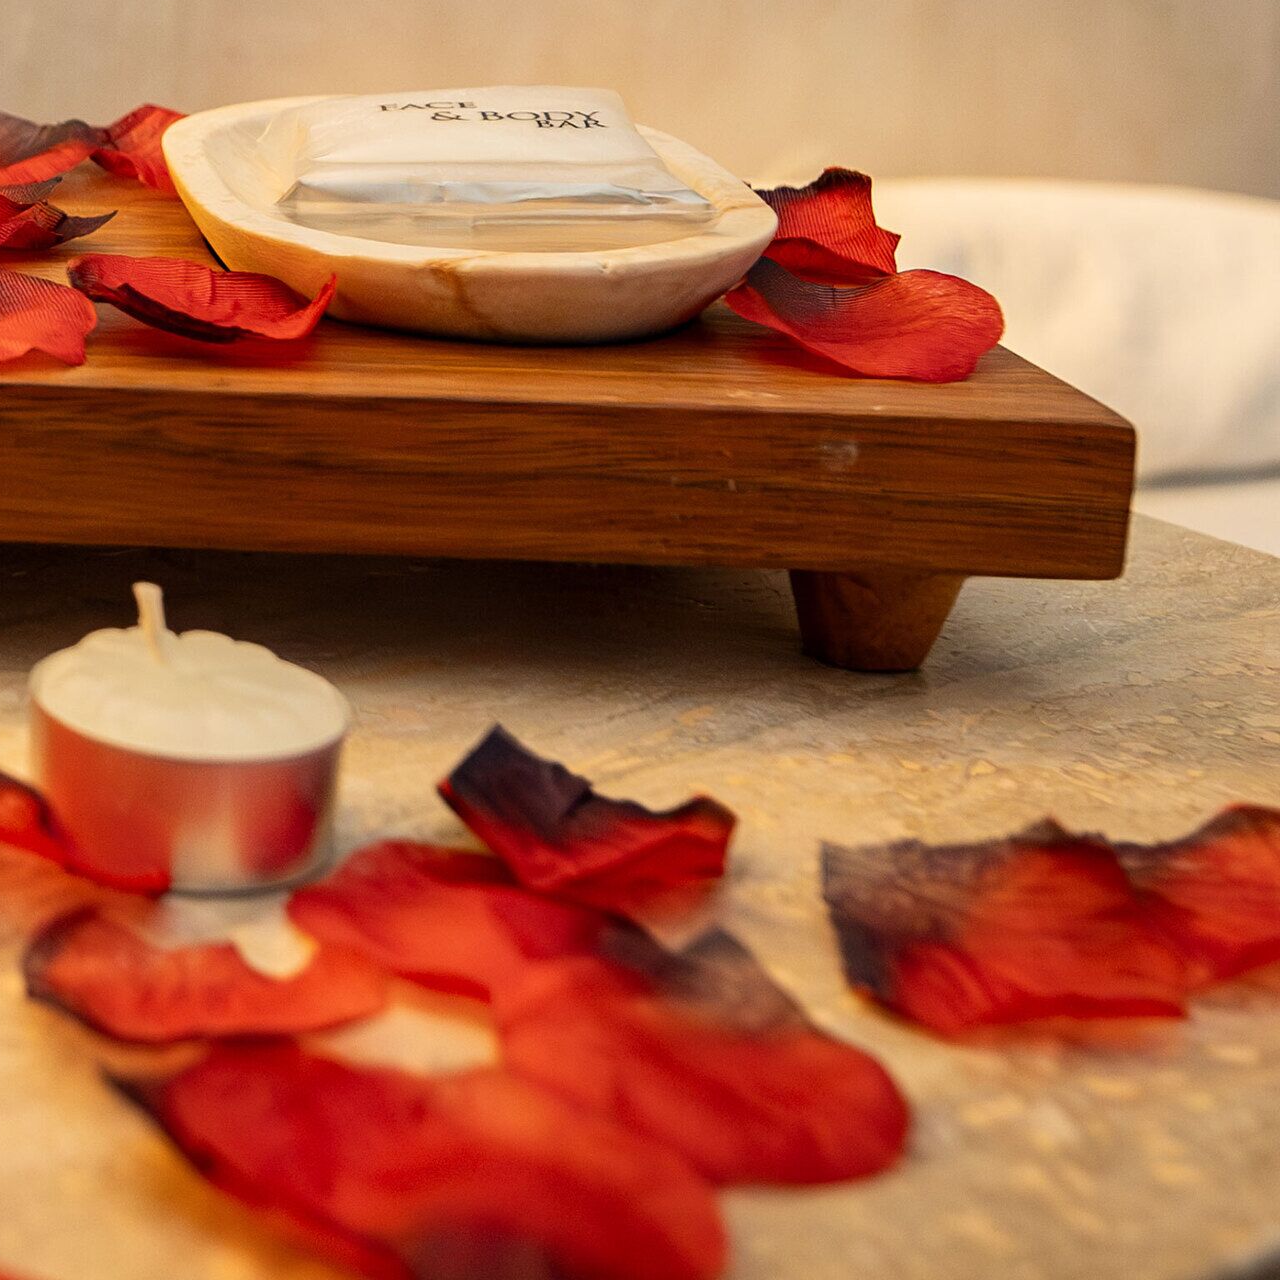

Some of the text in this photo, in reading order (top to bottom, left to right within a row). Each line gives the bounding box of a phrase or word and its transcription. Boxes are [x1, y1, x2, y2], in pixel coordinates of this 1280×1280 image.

[380, 101, 478, 112] FACE
[430, 110, 600, 122] & BODY
[536, 120, 608, 129] BAR
